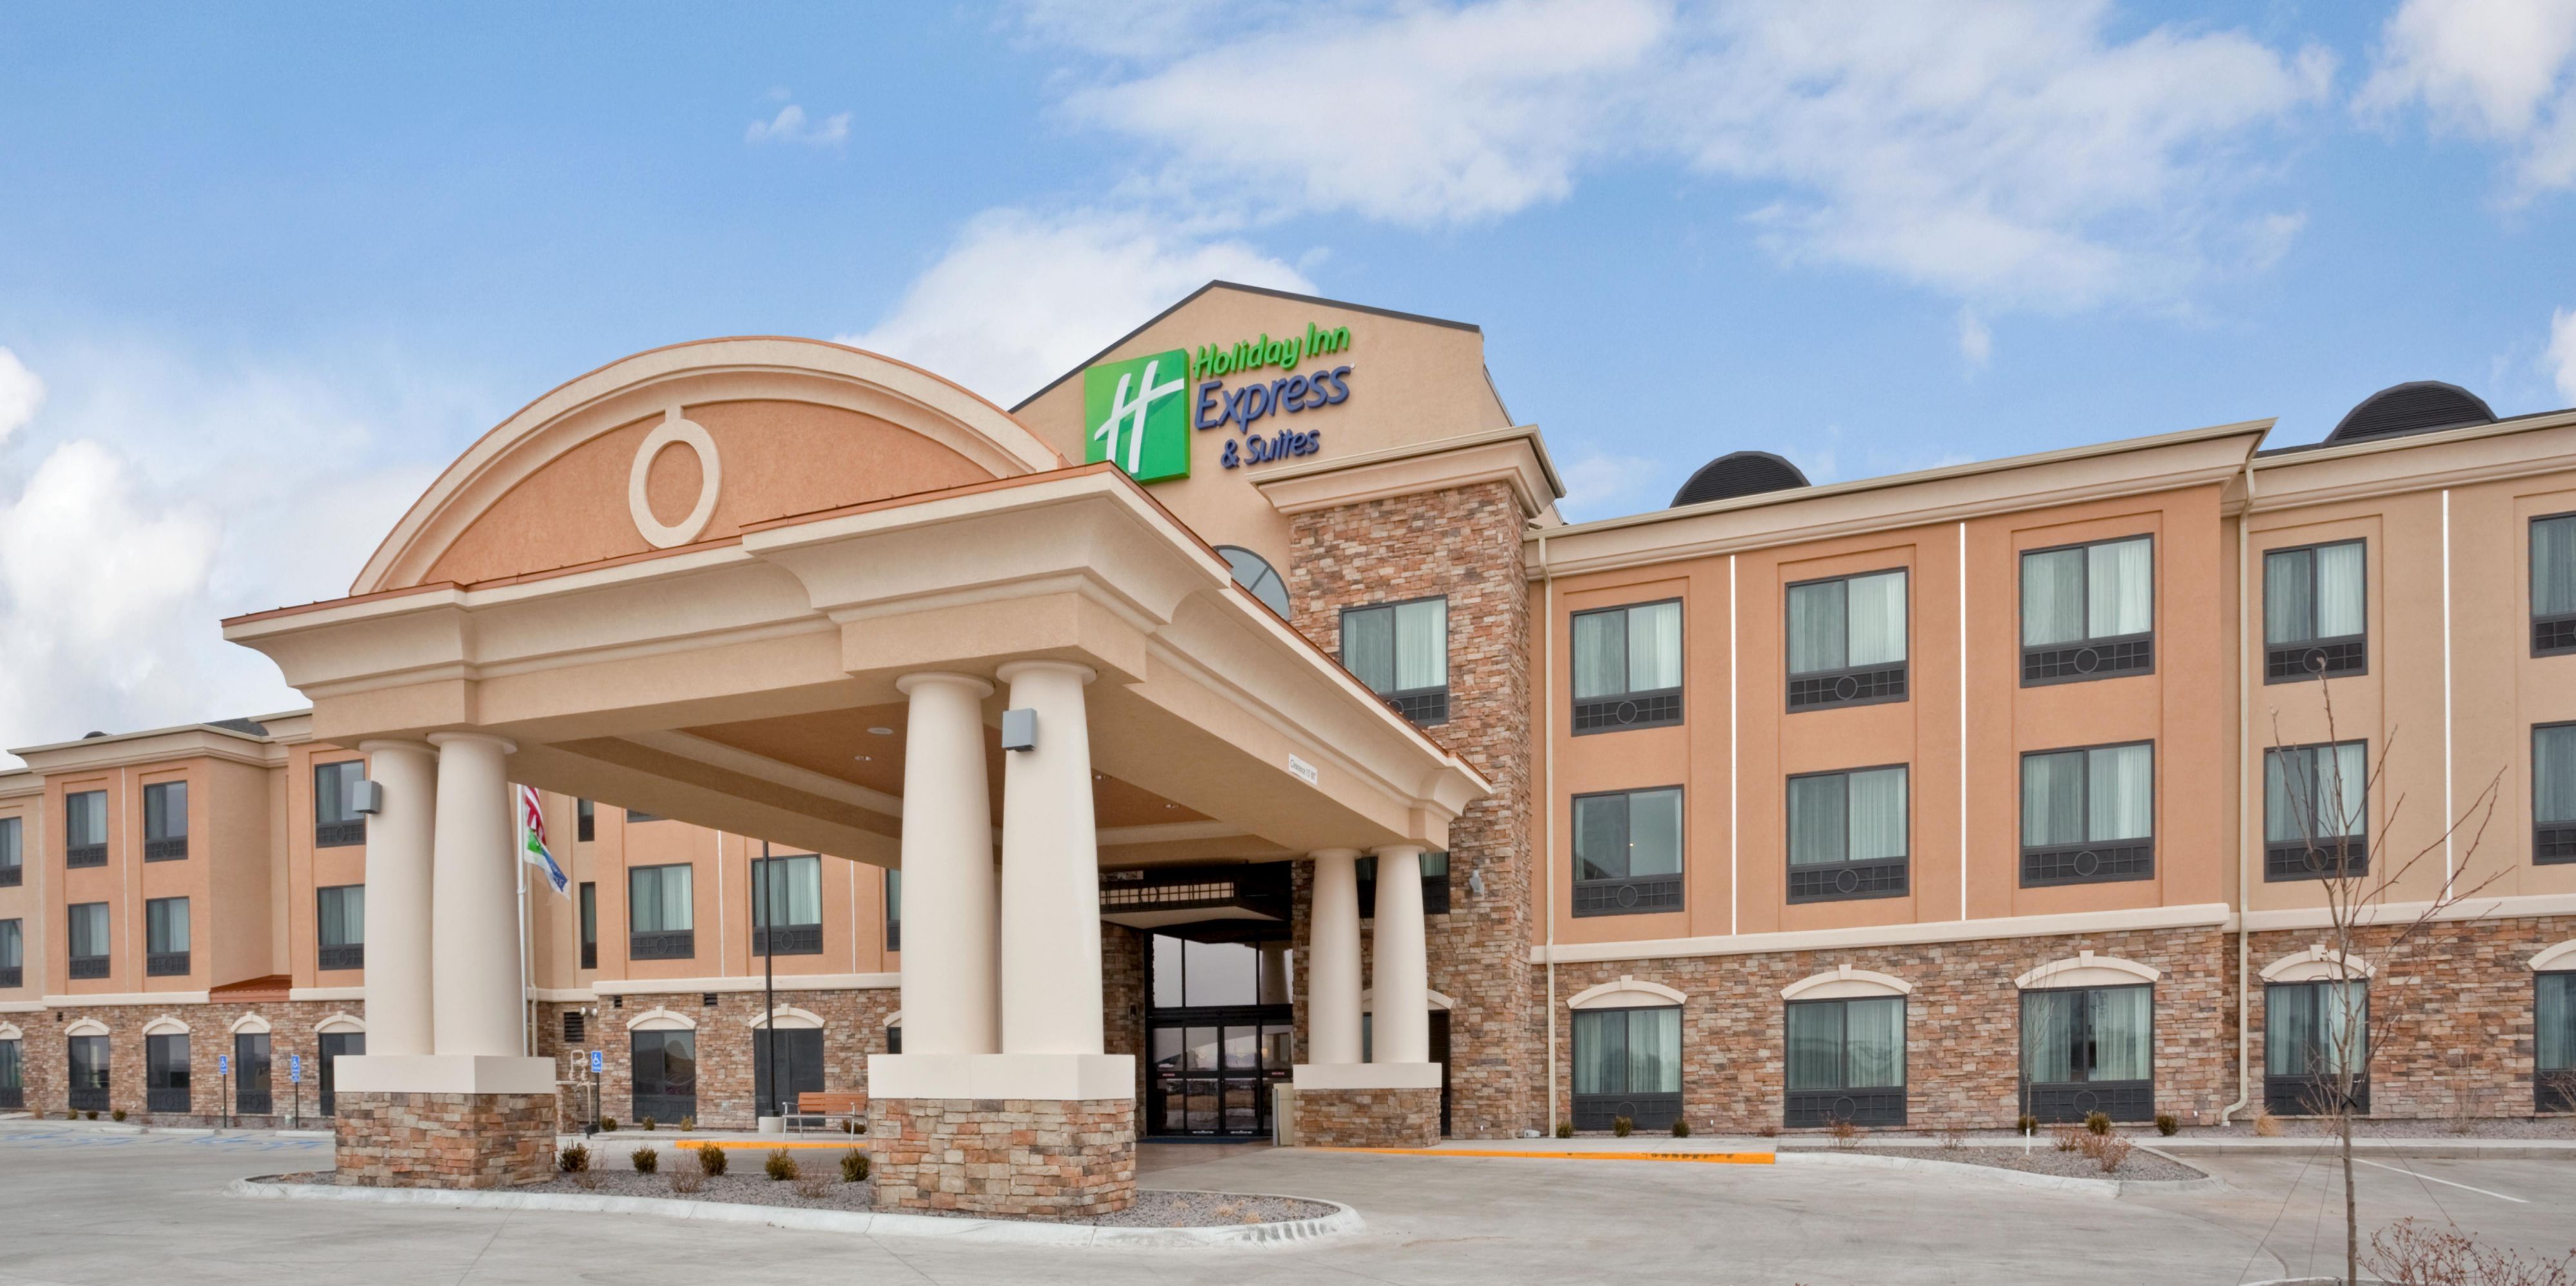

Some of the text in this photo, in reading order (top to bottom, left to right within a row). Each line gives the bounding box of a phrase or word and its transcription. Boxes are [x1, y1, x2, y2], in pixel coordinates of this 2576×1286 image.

[1193, 321, 1350, 381] Holiday Inn
[1195, 366, 1351, 435] Express
[1220, 429, 1321, 469] & Suites
